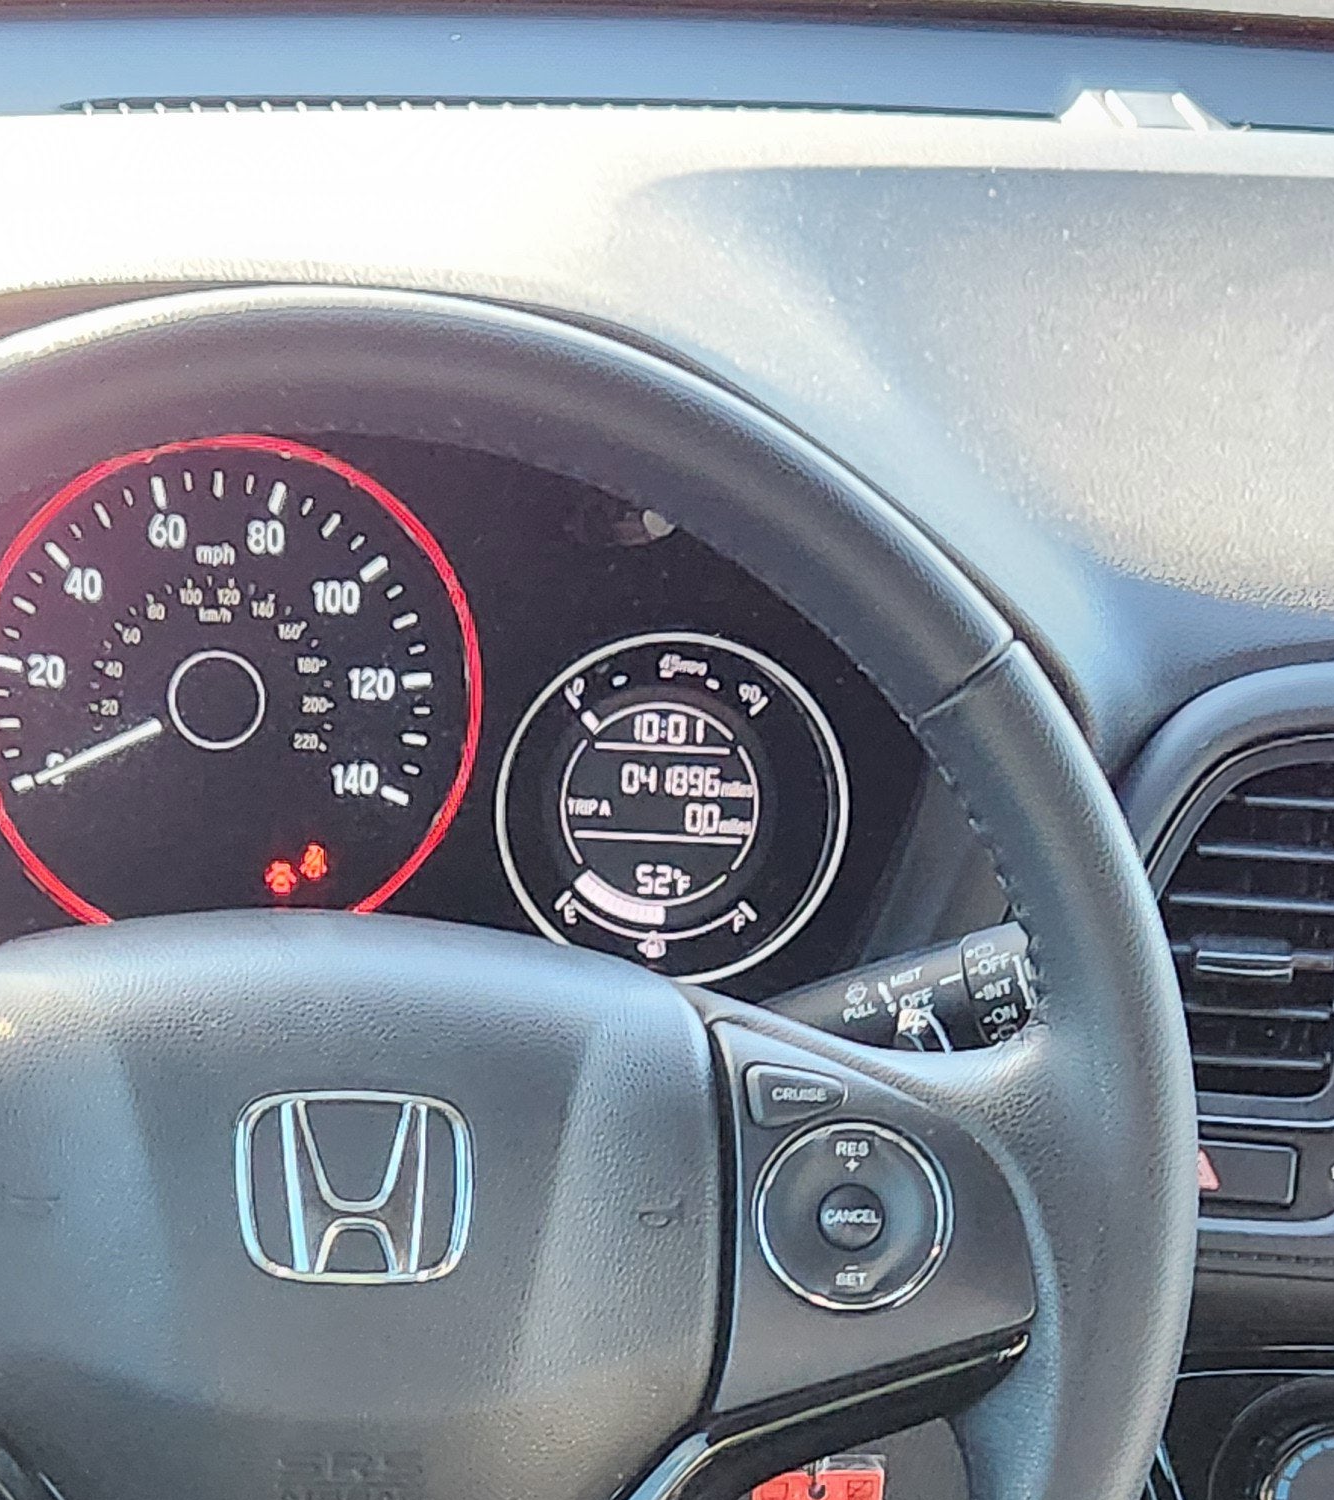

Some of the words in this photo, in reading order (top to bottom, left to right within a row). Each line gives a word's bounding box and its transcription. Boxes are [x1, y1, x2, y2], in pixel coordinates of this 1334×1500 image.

[148, 513, 187, 549] 60
[246, 519, 285, 555] 80
[195, 542, 236, 567] mph
[63, 566, 104, 602] 40
[179, 587, 204, 606] 100
[217, 587, 241, 606] 120
[311, 580, 361, 615] 100
[198, 606, 232, 624] km/h
[250, 600, 276, 618] 140
[121, 627, 141, 644] 60
[26, 653, 66, 689] 20
[103, 660, 123, 678] 40
[347, 667, 396, 701] 120
[738, 682, 762, 703] 90
[100, 699, 119, 716] 20
[301, 696, 327, 713] 200
[633, 712, 706, 744] 10:01
[293, 733, 318, 750] 220
[330, 762, 379, 795] 140
[621, 761, 721, 797] 041896
[567, 798, 598, 816] TRIP
[599, 799, 613, 817] A
[563, 905, 578, 925] E
[977, 952, 1011, 976] OFF
[899, 986, 934, 1010] OFF
[842, 1000, 878, 1024] PULL
[990, 1003, 1018, 1025] ON
[771, 1086, 828, 1102] CRUISE
[835, 1141, 870, 1158] RES
[823, 1208, 882, 1225] CANCEL
[835, 1271, 868, 1287] SET
